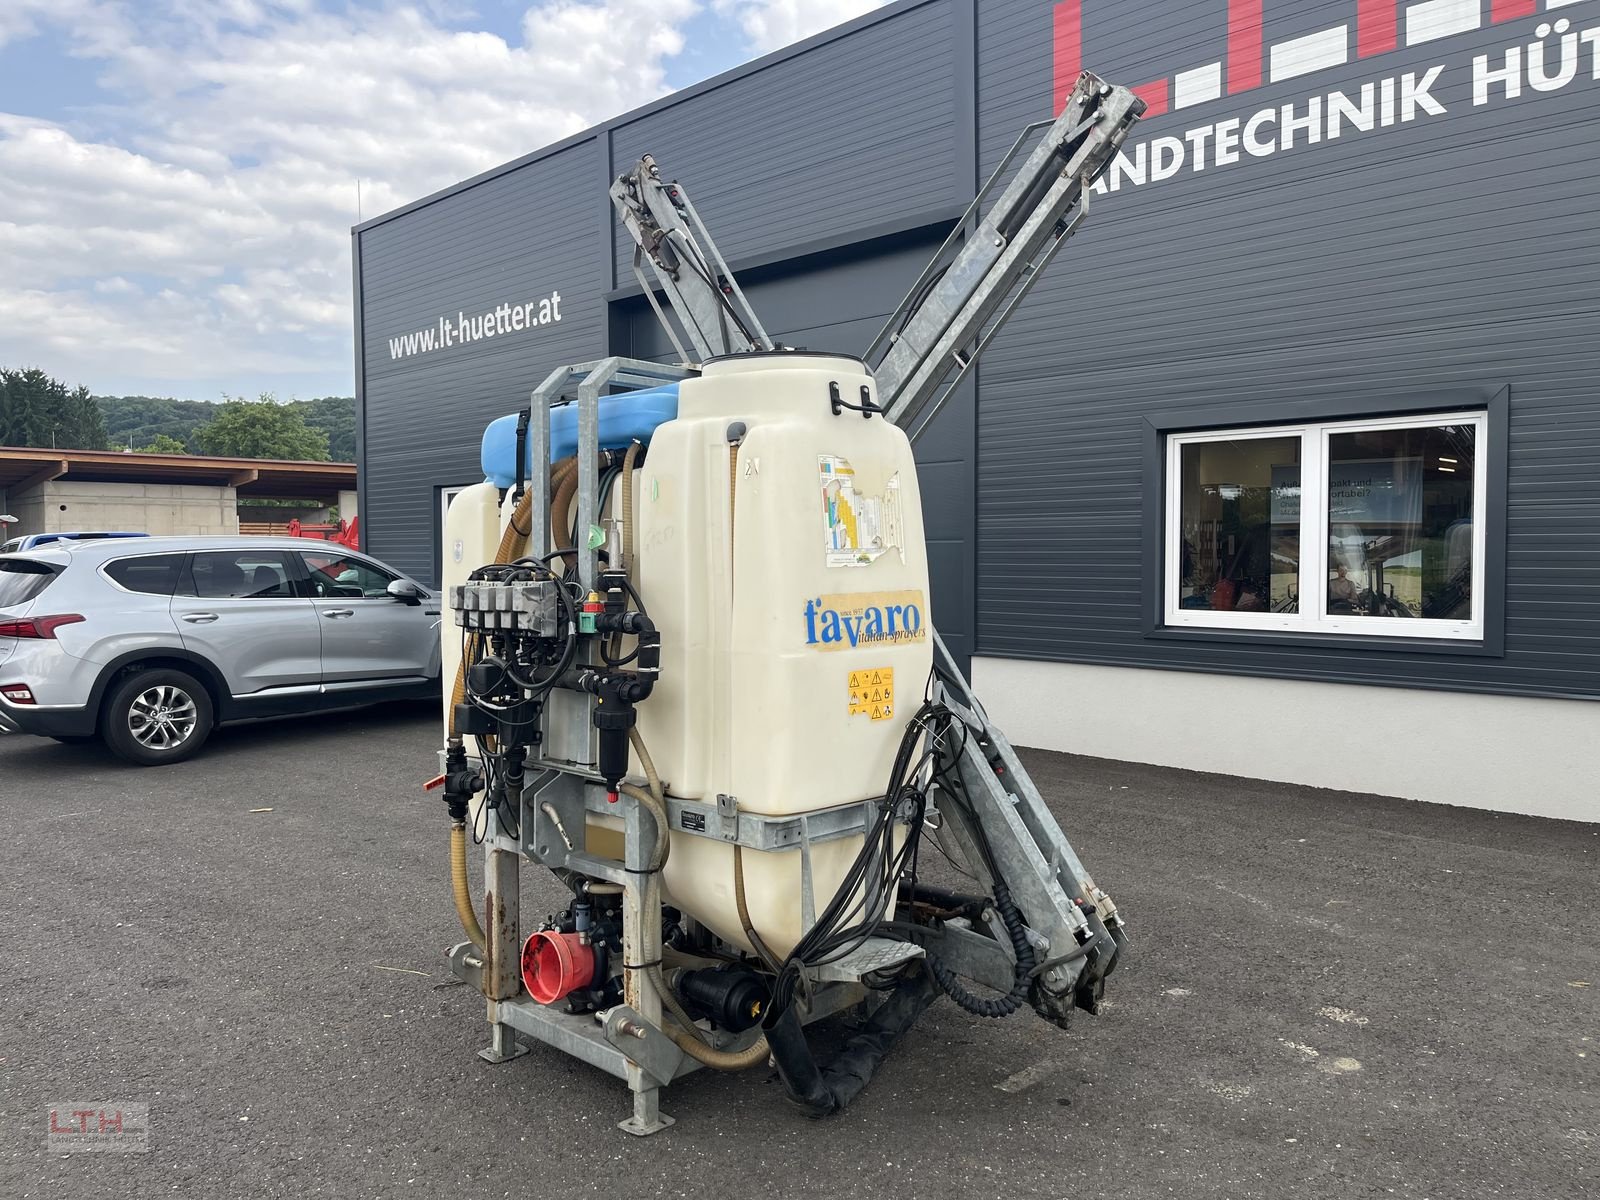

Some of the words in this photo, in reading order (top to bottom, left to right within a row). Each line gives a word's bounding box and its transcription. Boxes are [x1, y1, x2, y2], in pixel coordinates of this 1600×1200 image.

[1085, 64, 1447, 195] NDTECHNIK
[388, 290, 562, 360] www.lt-huetter.at
[804, 598, 920, 647] favaro
[858, 629, 888, 643] italian
[889, 627, 926, 643] sprayers
